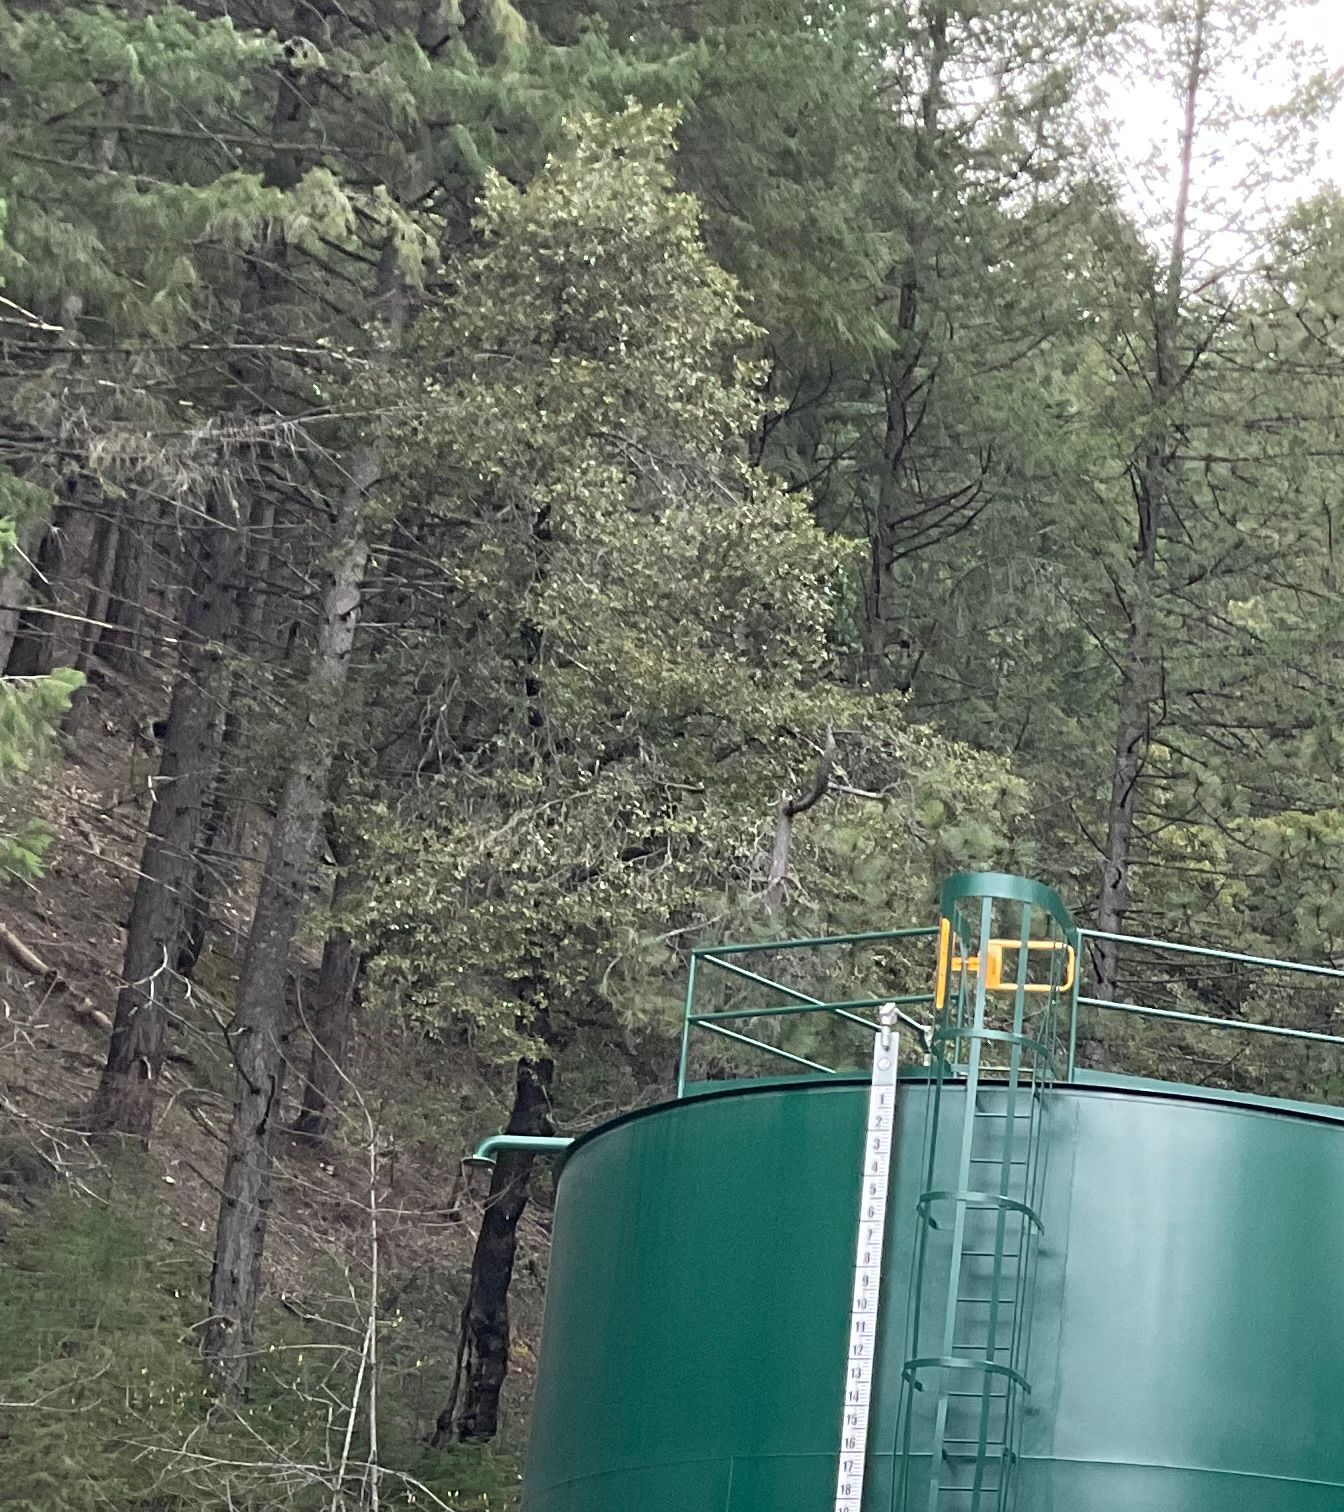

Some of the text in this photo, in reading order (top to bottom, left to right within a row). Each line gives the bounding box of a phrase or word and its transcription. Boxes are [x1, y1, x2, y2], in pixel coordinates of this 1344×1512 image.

[857, 1298, 867, 1310] 10
[855, 1321, 866, 1333] 11
[853, 1344, 864, 1356] 12
[851, 1368, 862, 1379] 13
[848, 1391, 859, 1402] 14
[846, 1414, 857, 1425] 15
[845, 1437, 856, 1448] 16
[843, 1461, 854, 1472] 17
[841, 1484, 852, 1495] 18
